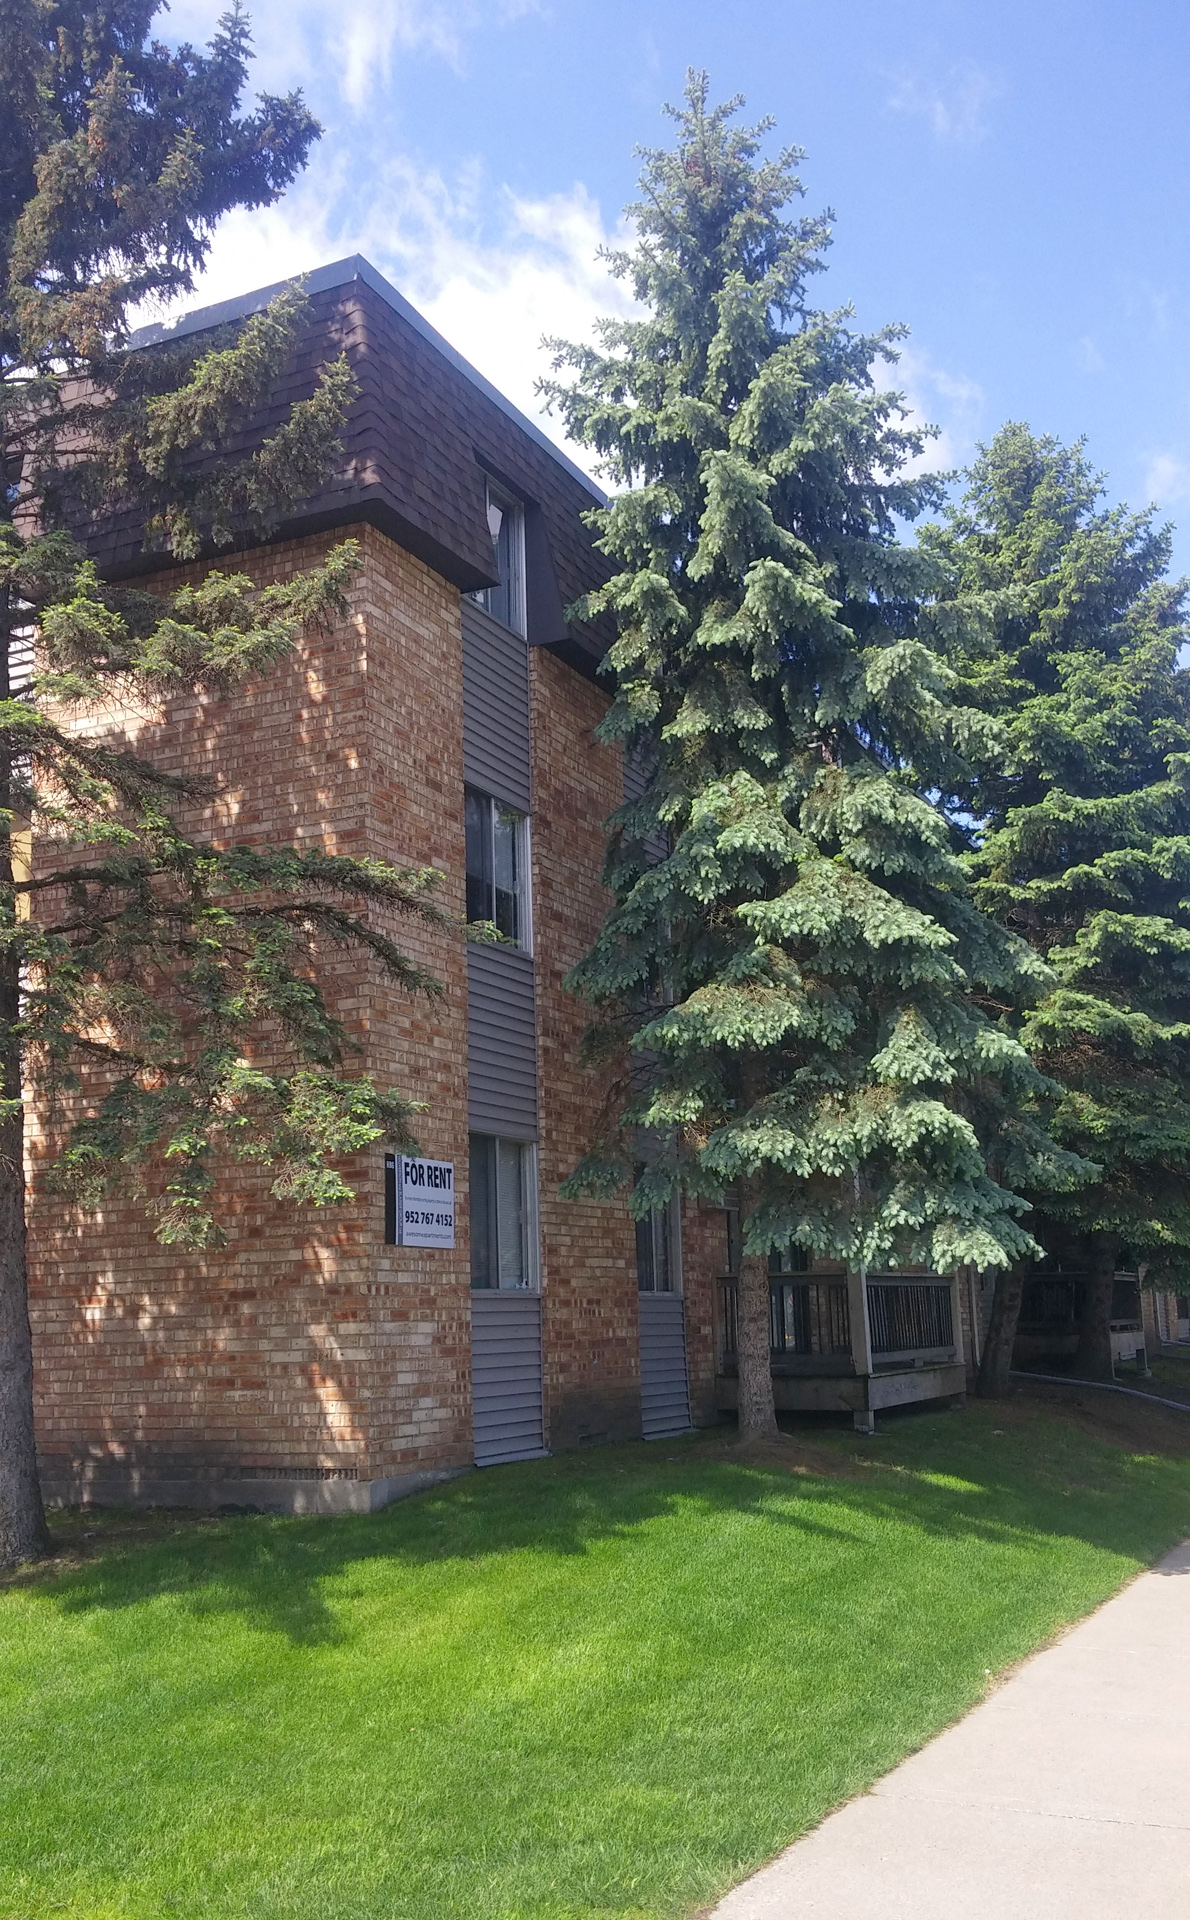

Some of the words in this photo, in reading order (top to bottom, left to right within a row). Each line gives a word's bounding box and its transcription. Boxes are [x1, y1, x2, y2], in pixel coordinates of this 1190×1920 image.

[404, 1162, 425, 1187] FOR
[427, 1165, 453, 1190] RENT
[405, 1210, 419, 1224] 952
[421, 1212, 434, 1225] 767
[435, 1213, 453, 1227] 4152
